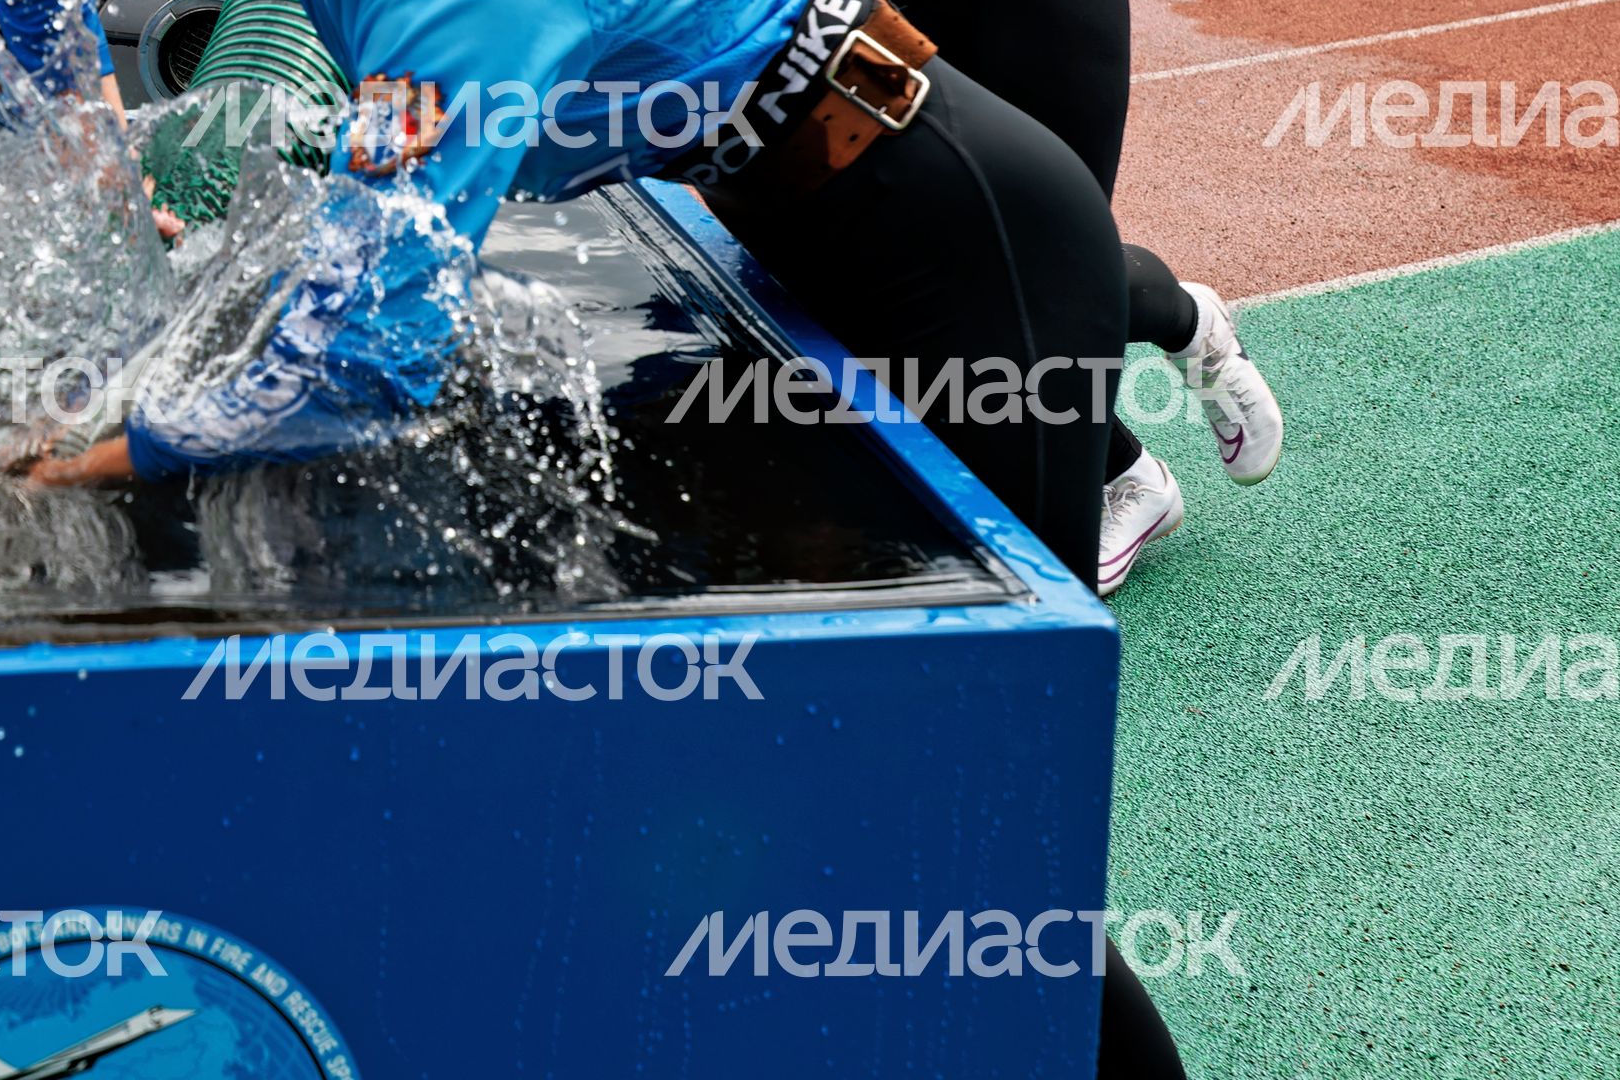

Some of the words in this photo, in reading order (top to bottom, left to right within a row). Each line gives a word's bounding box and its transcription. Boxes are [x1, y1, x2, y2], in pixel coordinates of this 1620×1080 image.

[187, 928, 209, 952] IN
[208, 936, 253, 973] FIRE
[250, 962, 289, 997] AND
[282, 990, 338, 1056] RESCUE
[326, 1054, 356, 1080] SP
